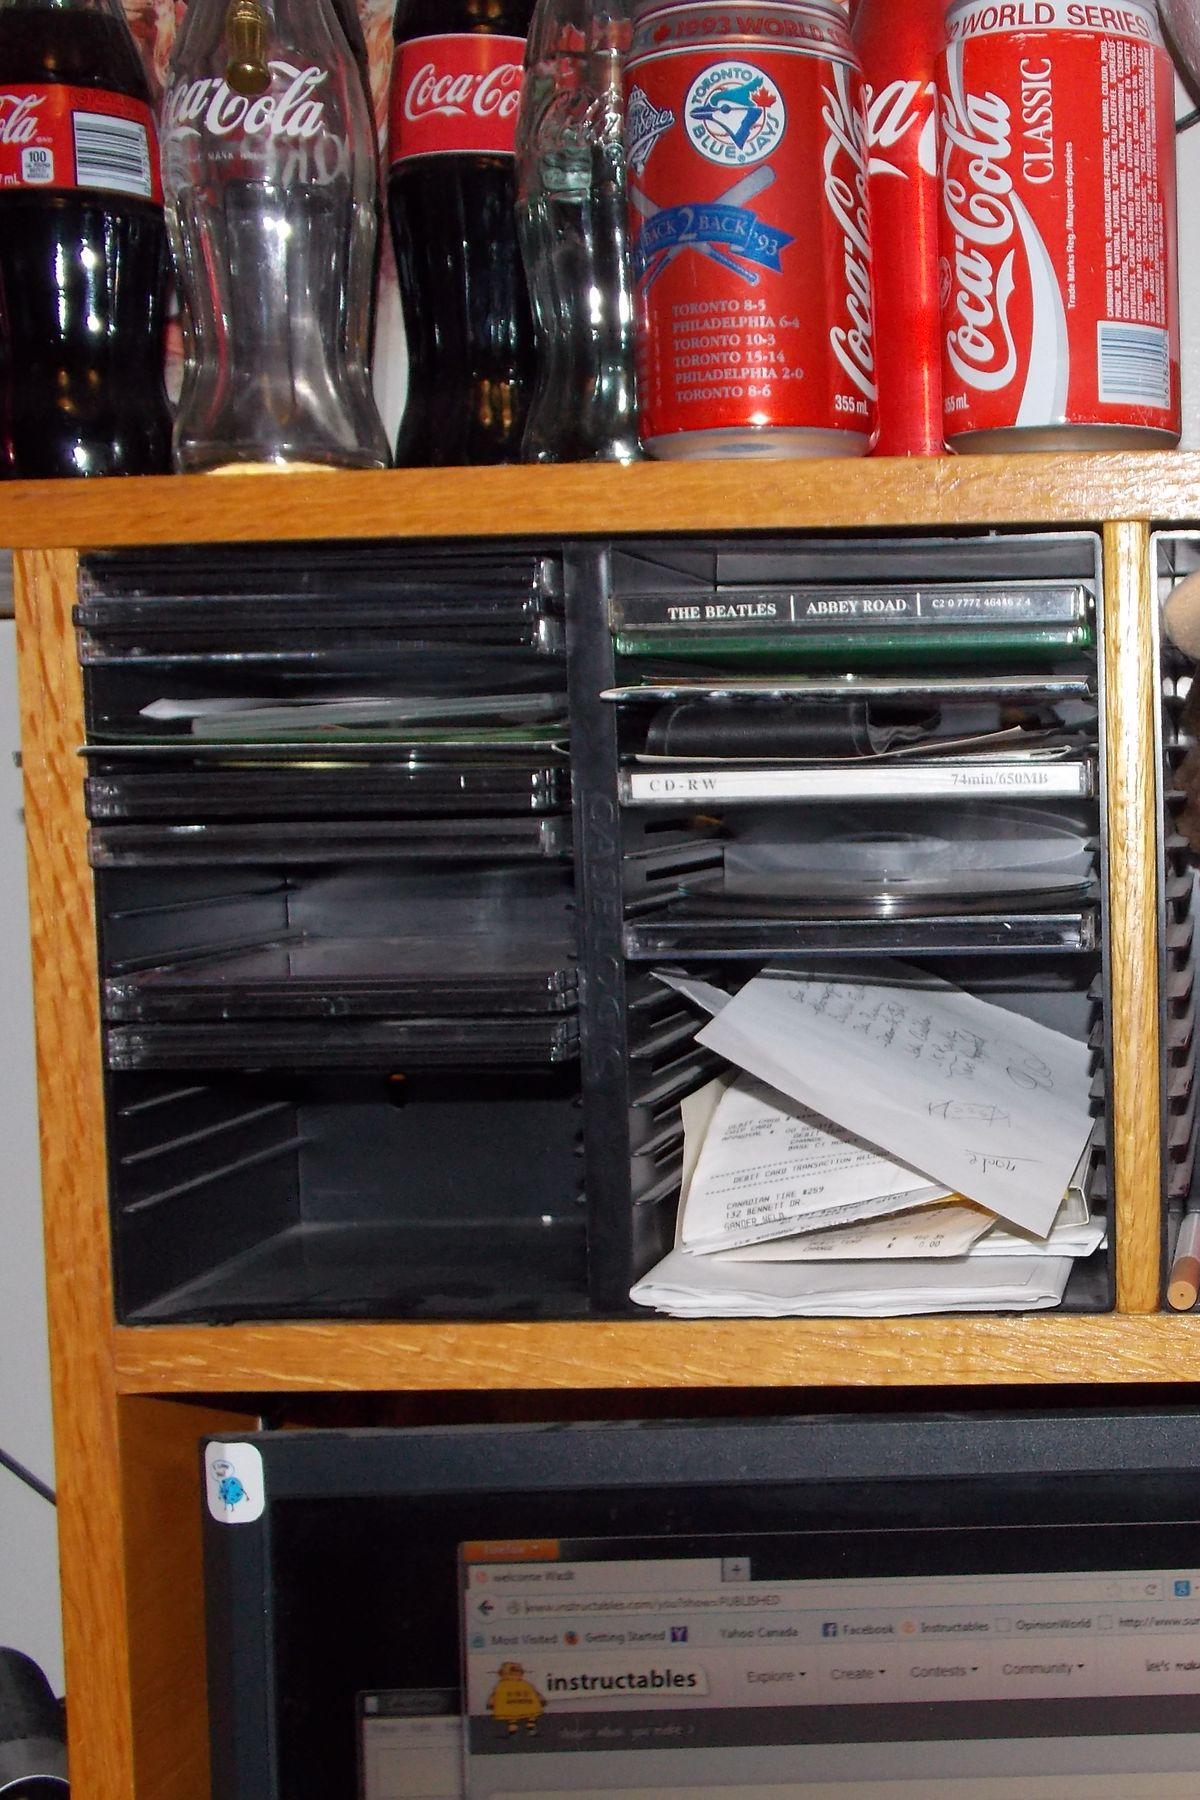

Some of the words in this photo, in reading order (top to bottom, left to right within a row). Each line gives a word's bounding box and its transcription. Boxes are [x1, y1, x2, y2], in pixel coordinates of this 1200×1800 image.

[675, 16, 731, 38] 1993
[736, 15, 825, 43] WORLD
[962, 2, 1056, 38] WORLD
[403, 62, 522, 122] Coca-Co
[691, 67, 754, 106] TORONTO
[1019, 58, 1055, 185] CLASSIC
[692, 123, 738, 160] BLUE
[746, 112, 781, 160] JAYS
[29, 150, 47, 163] 100
[642, 218, 677, 246] BACK
[677, 206, 699, 241] 2
[699, 213, 748, 237] BACK
[942, 88, 1017, 391] Coca-Cola
[1067, 254, 1075, 281] Marks
[1068, 284, 1076, 308] Trade
[671, 299, 740, 318] TORONTO
[671, 315, 776, 333] PHILADELPHIA
[672, 333, 741, 351] TORONTO
[673, 350, 742, 368] TORONTO
[674, 366, 778, 385] PHILADELPHIA
[675, 385, 744, 402] TORONTO
[834, 393, 856, 412] 355
[955, 392, 970, 409] mL
[668, 606, 702, 621] THE
[705, 602, 777, 619] BEATLES
[806, 599, 858, 615] ABBEY
[862, 597, 907, 613] ROAD
[950, 770, 1049, 788] 74min/650MB
[726, 1195, 770, 1210] CANADIAN
[775, 1190, 797, 1201] TIRE
[755, 1625, 799, 1639] Canada
[842, 1622, 894, 1636] Facebook
[746, 1668, 794, 1685] Explore
[831, 1666, 875, 1681] Create
[1002, 1660, 1074, 1678] Community
[546, 1668, 697, 1693] instructables
